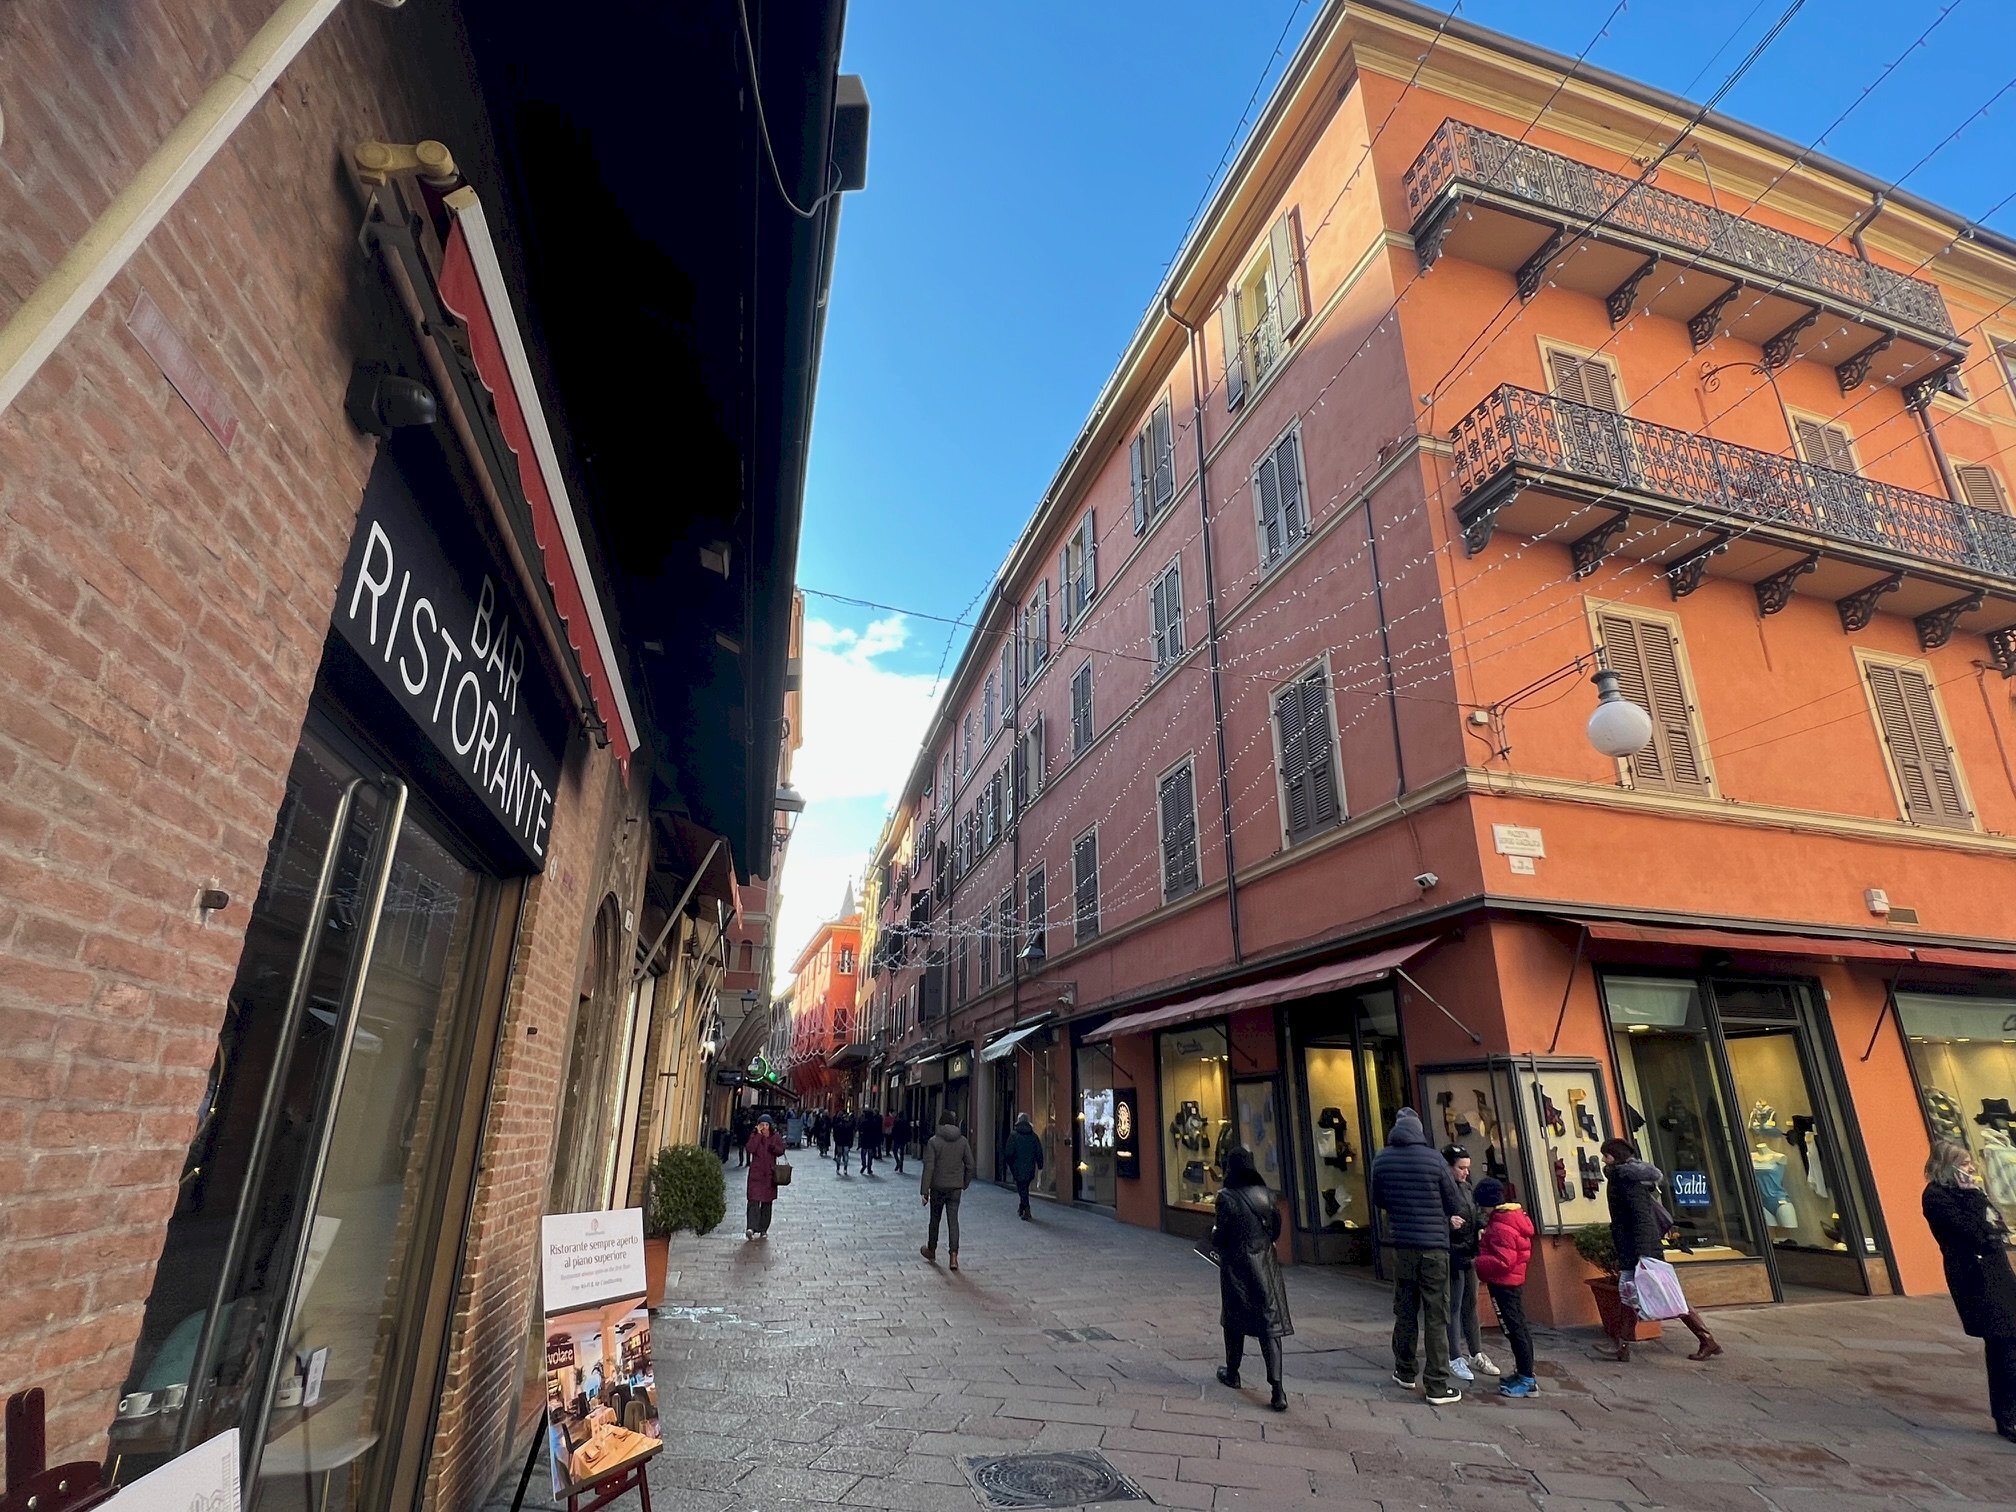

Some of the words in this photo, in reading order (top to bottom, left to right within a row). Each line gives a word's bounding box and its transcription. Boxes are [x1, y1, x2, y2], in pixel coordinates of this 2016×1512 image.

[471, 574, 525, 715] BAR
[349, 520, 552, 857] RISTORANTE
[1675, 1174, 1707, 1195] Saldi
[549, 1241, 589, 1256] Ristorante
[590, 1239, 616, 1251] sempre
[616, 1235, 639, 1249] aperto
[564, 1257, 571, 1268] al
[572, 1255, 593, 1270] piano
[594, 1250, 627, 1265] superiore
